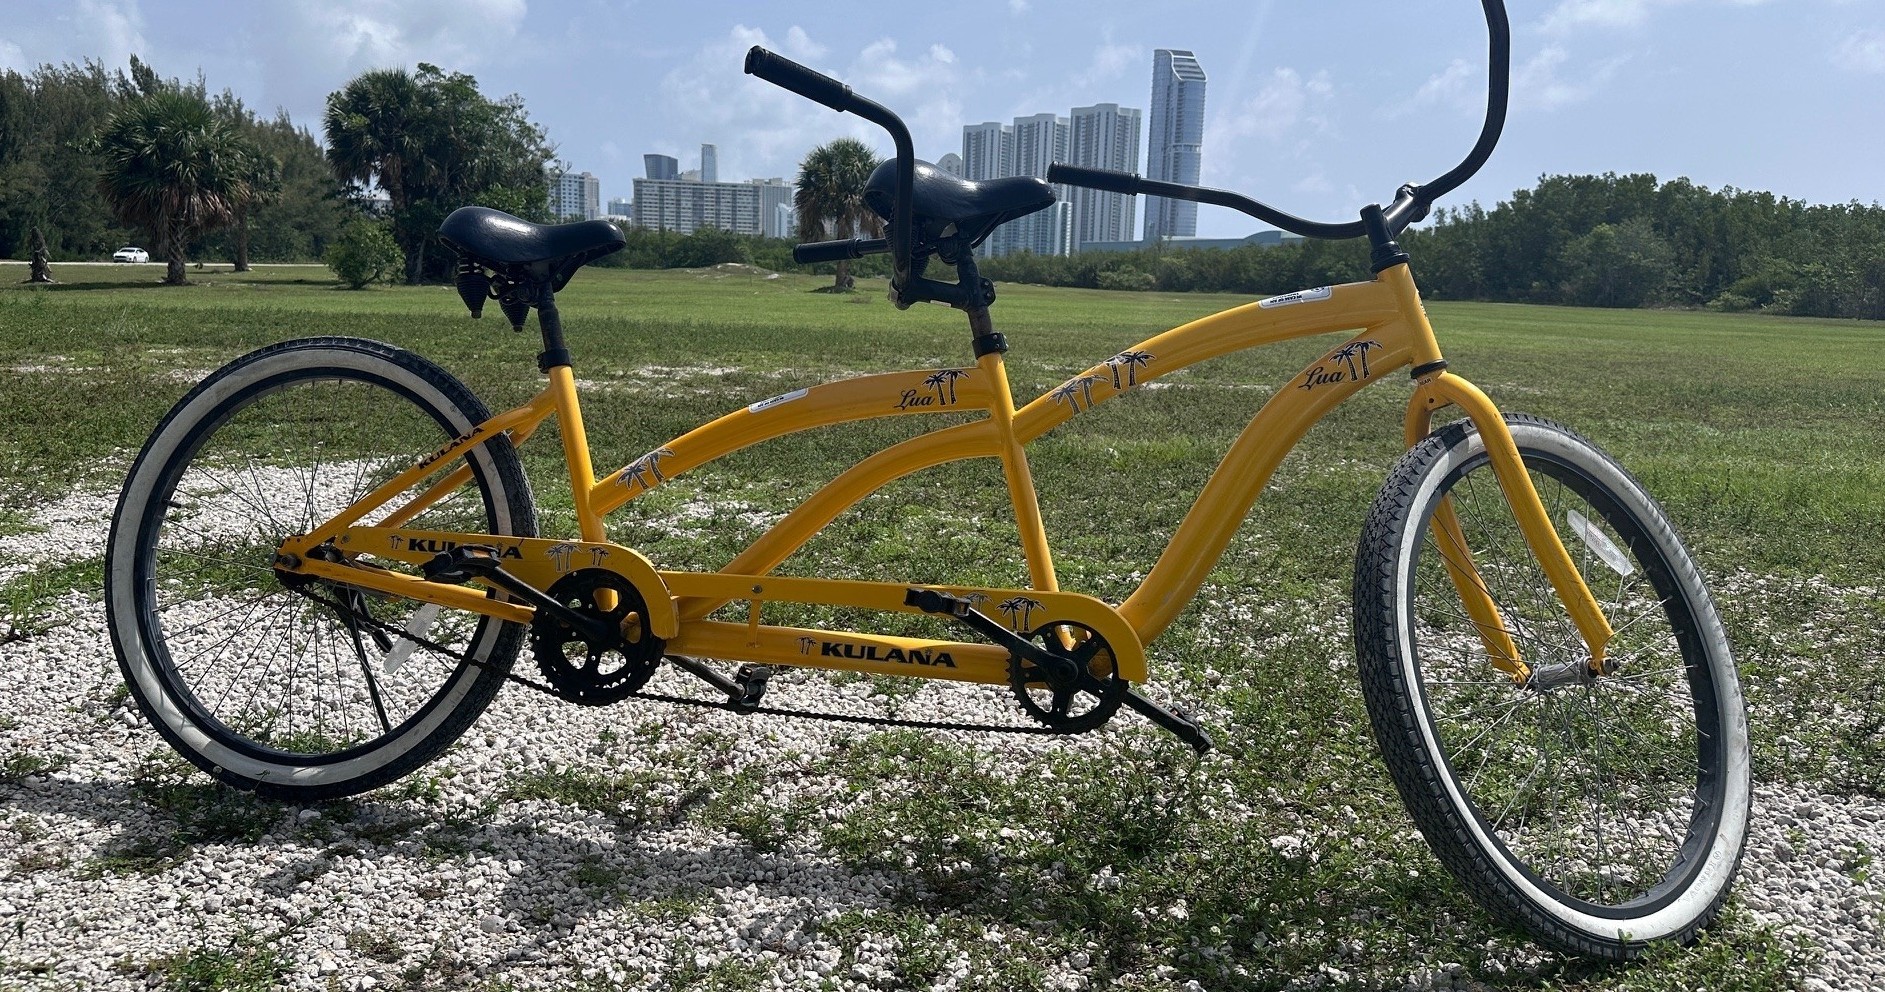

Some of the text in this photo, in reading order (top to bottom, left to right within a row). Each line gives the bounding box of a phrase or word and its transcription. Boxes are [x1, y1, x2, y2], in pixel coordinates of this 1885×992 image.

[1298, 366, 1346, 390] Lua
[893, 389, 936, 410] Lua
[418, 427, 485, 469] KULANA
[408, 538, 524, 560] KUA
[821, 641, 958, 668] KULANA
